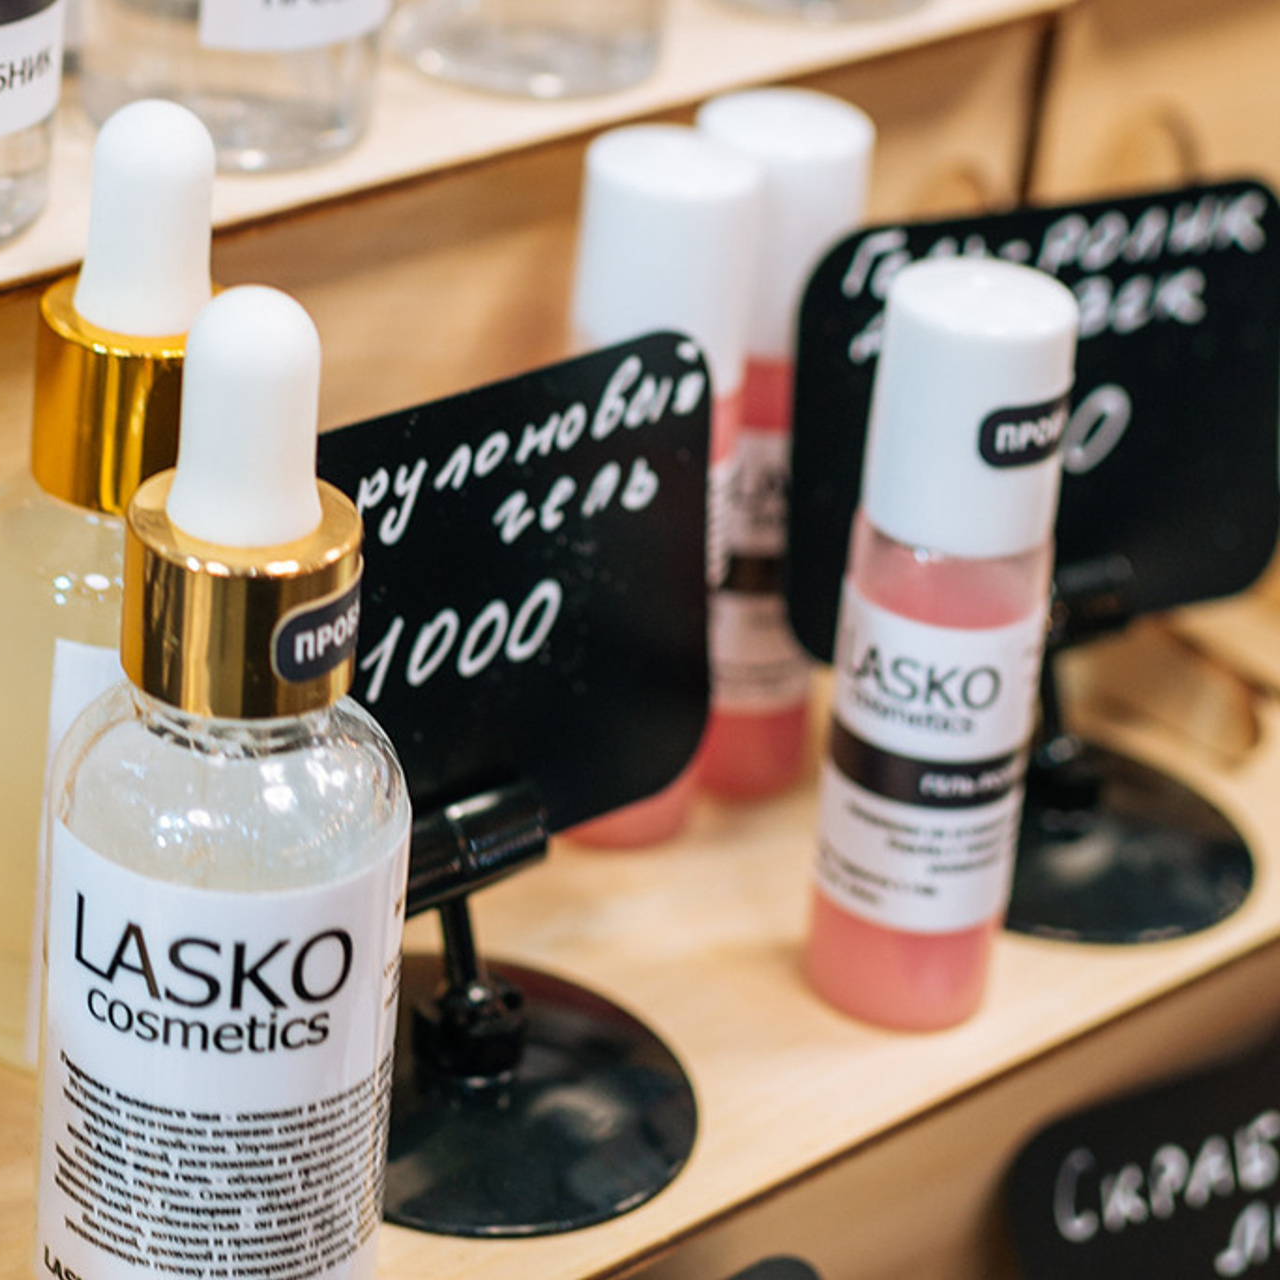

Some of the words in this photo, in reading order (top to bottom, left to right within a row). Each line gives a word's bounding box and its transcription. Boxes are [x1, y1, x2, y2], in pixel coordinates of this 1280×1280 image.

[360, 579, 563, 704] 1000
[75, 891, 353, 1010] LASKO
[87, 987, 331, 1054] cosmetics
